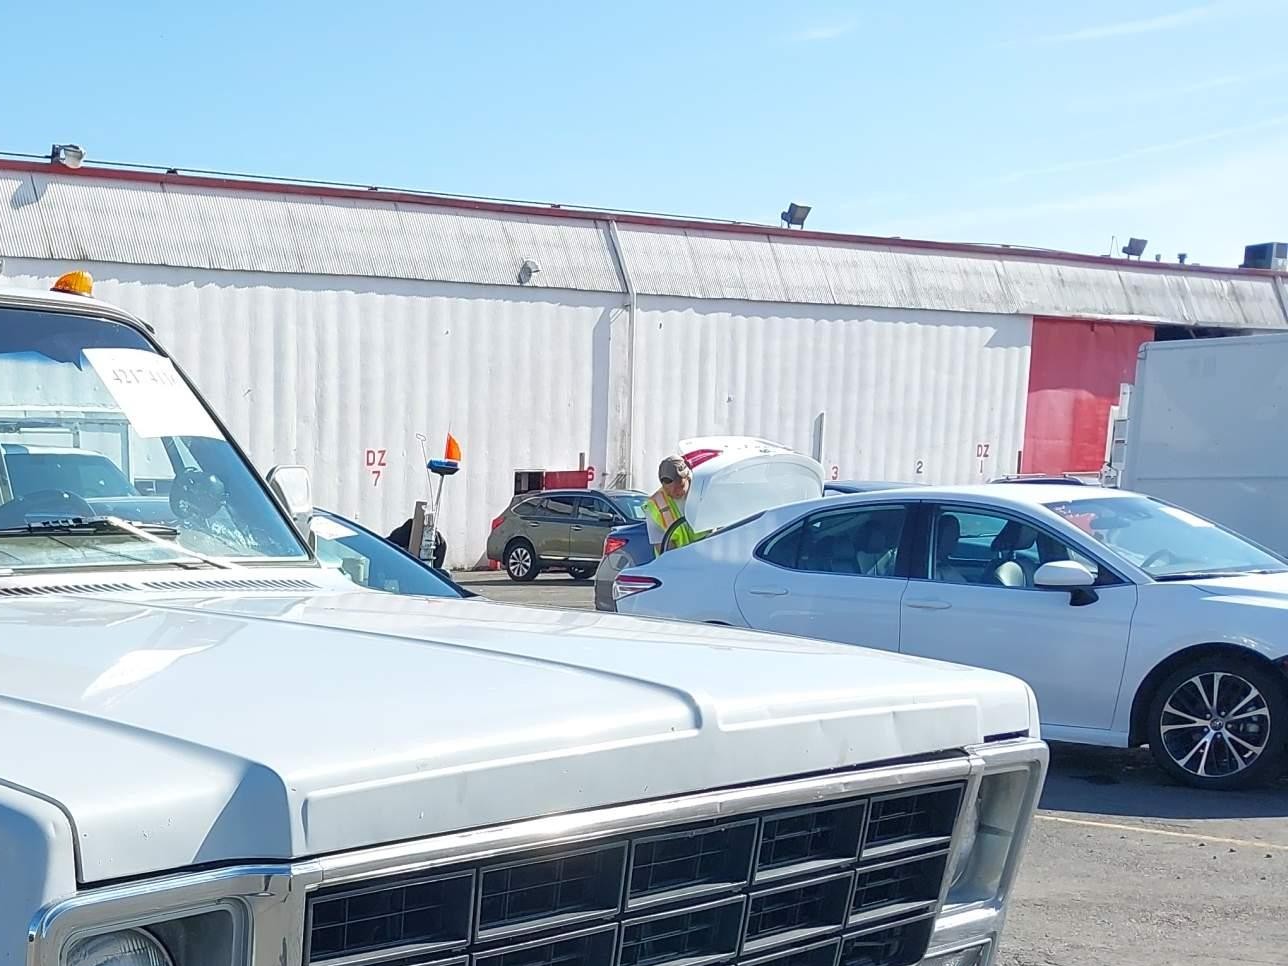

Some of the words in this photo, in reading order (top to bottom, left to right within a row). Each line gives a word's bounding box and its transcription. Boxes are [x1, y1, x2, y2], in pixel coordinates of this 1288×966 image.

[976, 444, 990, 457] DZ
[366, 450, 387, 466] DZ
[831, 466, 839, 480] 3
[916, 461, 924, 474] 2
[371, 470, 381, 486] 7
